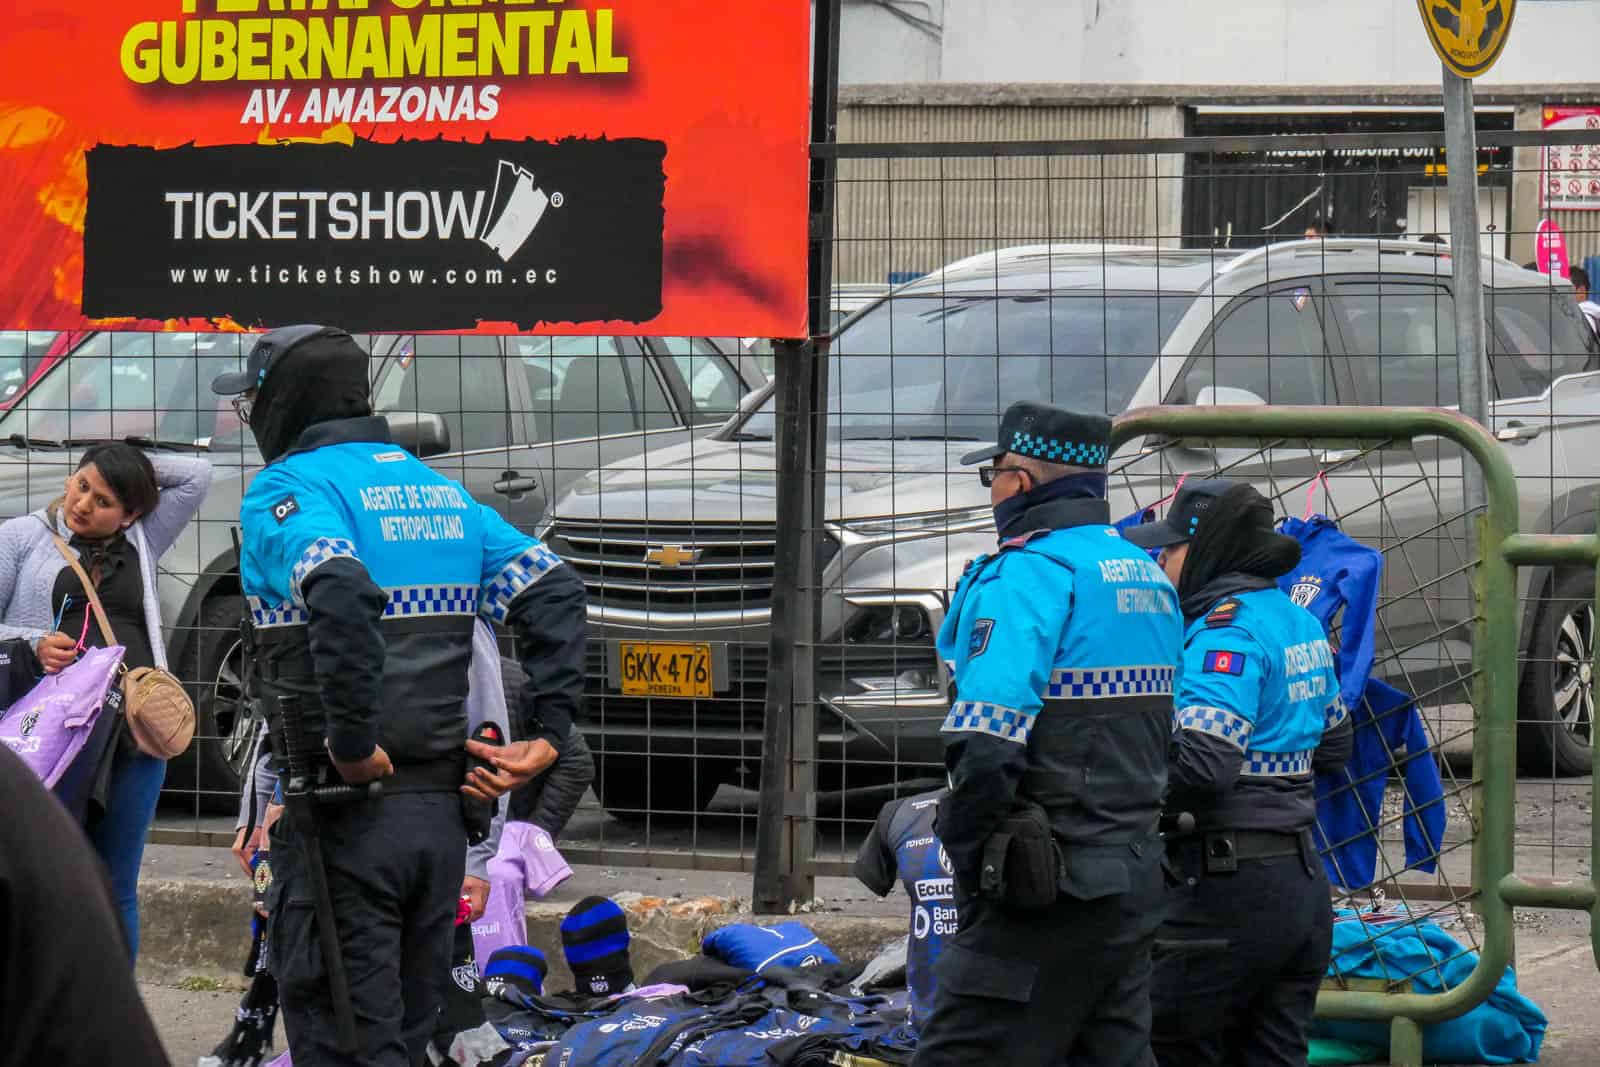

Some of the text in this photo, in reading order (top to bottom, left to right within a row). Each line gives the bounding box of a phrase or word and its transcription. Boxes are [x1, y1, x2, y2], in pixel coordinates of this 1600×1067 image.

[120, 9, 629, 85] GUBERNAMENTAL
[240, 84, 501, 124] AV. AMAZONAS
[165, 191, 486, 239] TICKETSHOW
[170, 264, 558, 284] www.ticketshow.com.ec
[359, 485, 468, 512] AGENTE DE CONTROL
[380, 515, 464, 542] METROPOLITANO
